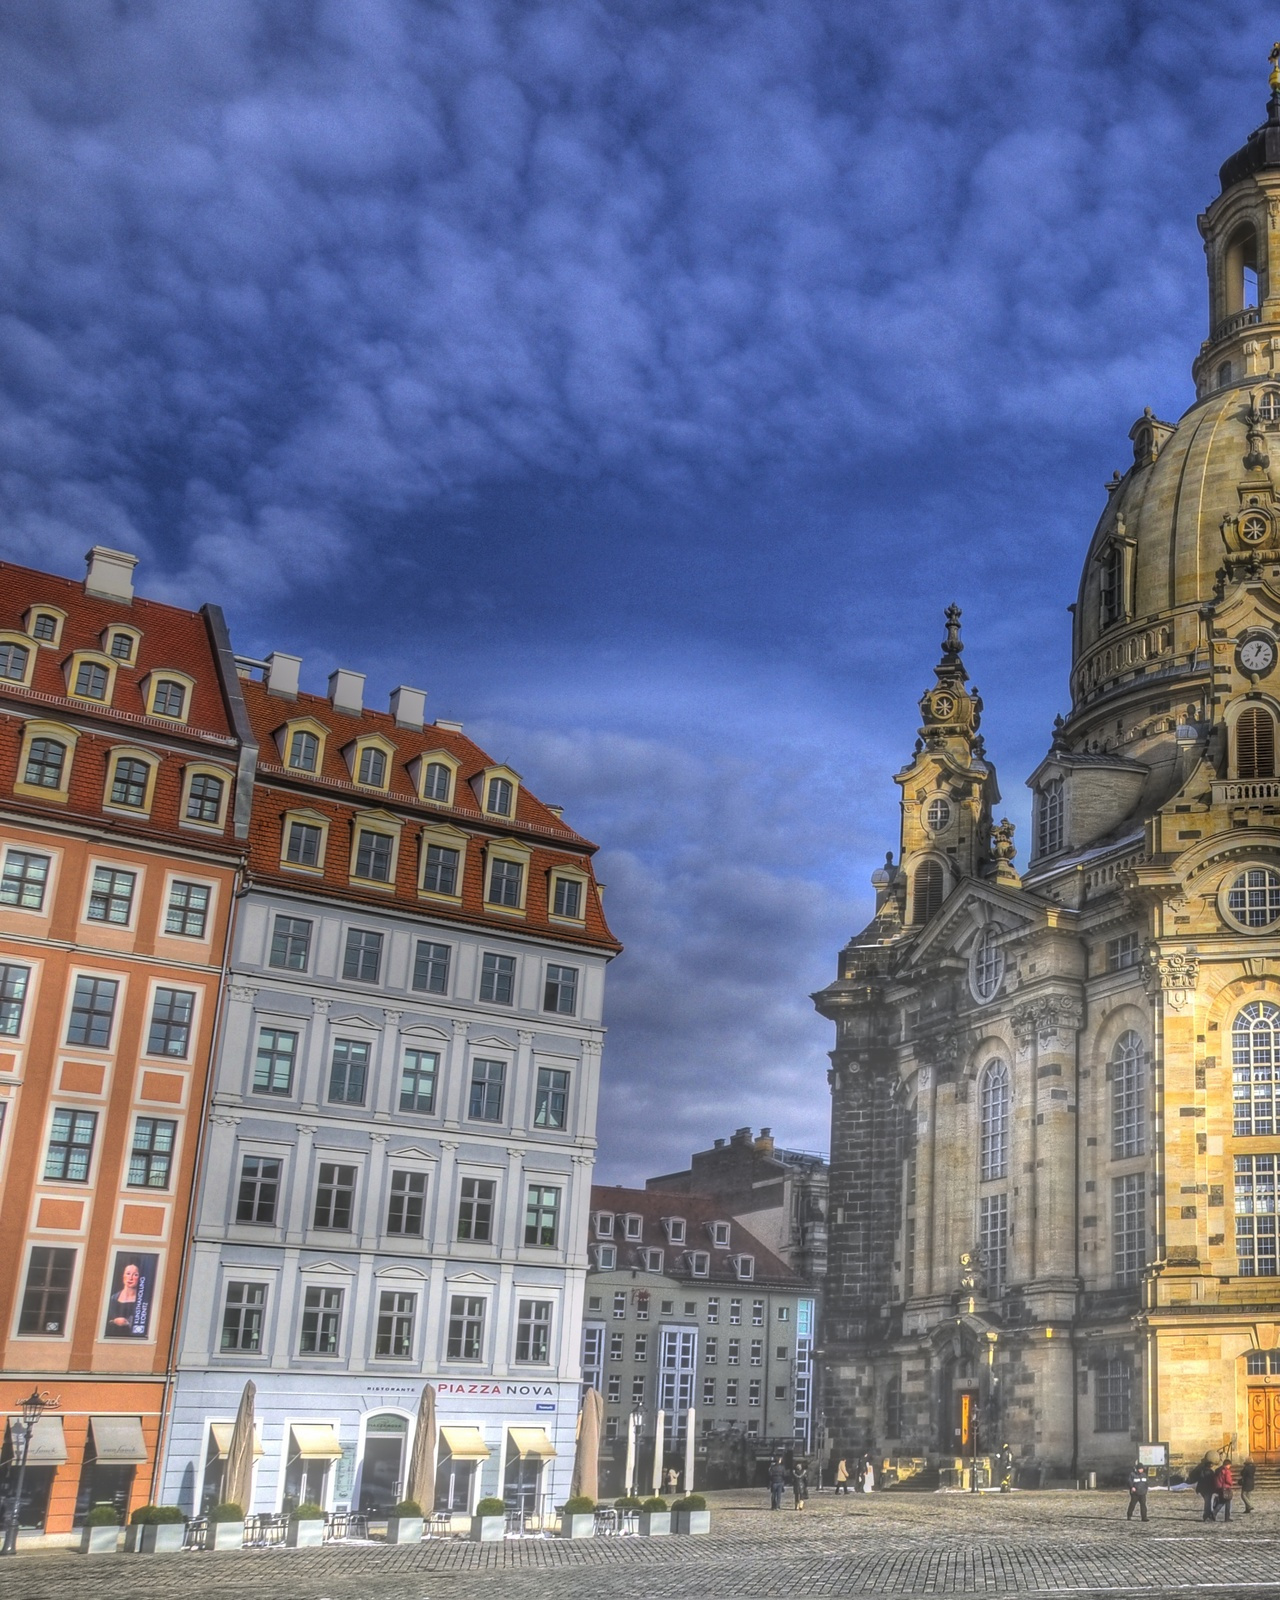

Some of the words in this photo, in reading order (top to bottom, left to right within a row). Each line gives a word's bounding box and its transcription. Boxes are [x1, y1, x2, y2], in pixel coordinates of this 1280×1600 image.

[134, 1276, 146, 1324] KUNSTHANDLUNG
[1264, 1376, 1271, 1384] C
[437, 1383, 501, 1394] PIAZZA
[506, 1385, 553, 1396] NOVA
